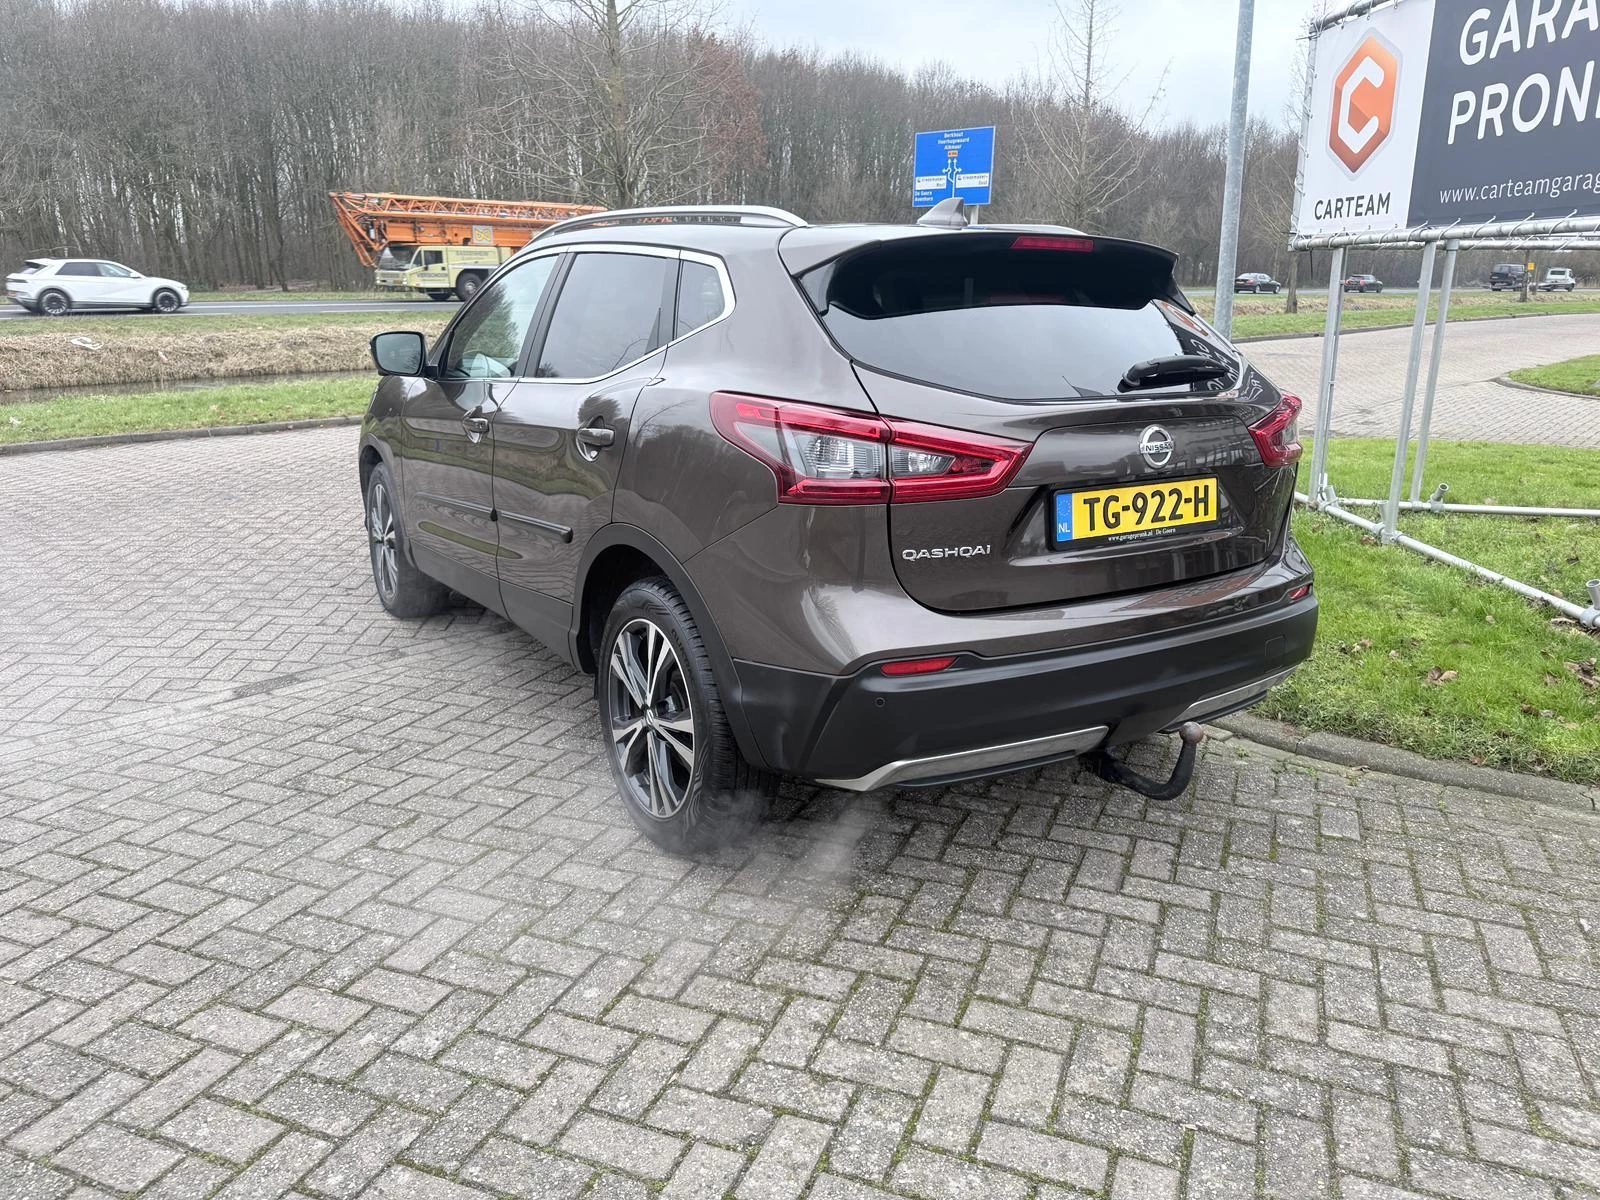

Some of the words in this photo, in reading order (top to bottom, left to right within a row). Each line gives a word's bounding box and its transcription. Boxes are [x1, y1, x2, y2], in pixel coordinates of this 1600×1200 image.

[1447, 60, 1600, 145] PRON
[1314, 192, 1391, 221] CARTEAM
[1145, 442, 1173, 452] NISSAN
[1083, 484, 1209, 531] TG-922-H
[1058, 523, 1071, 533] NL
